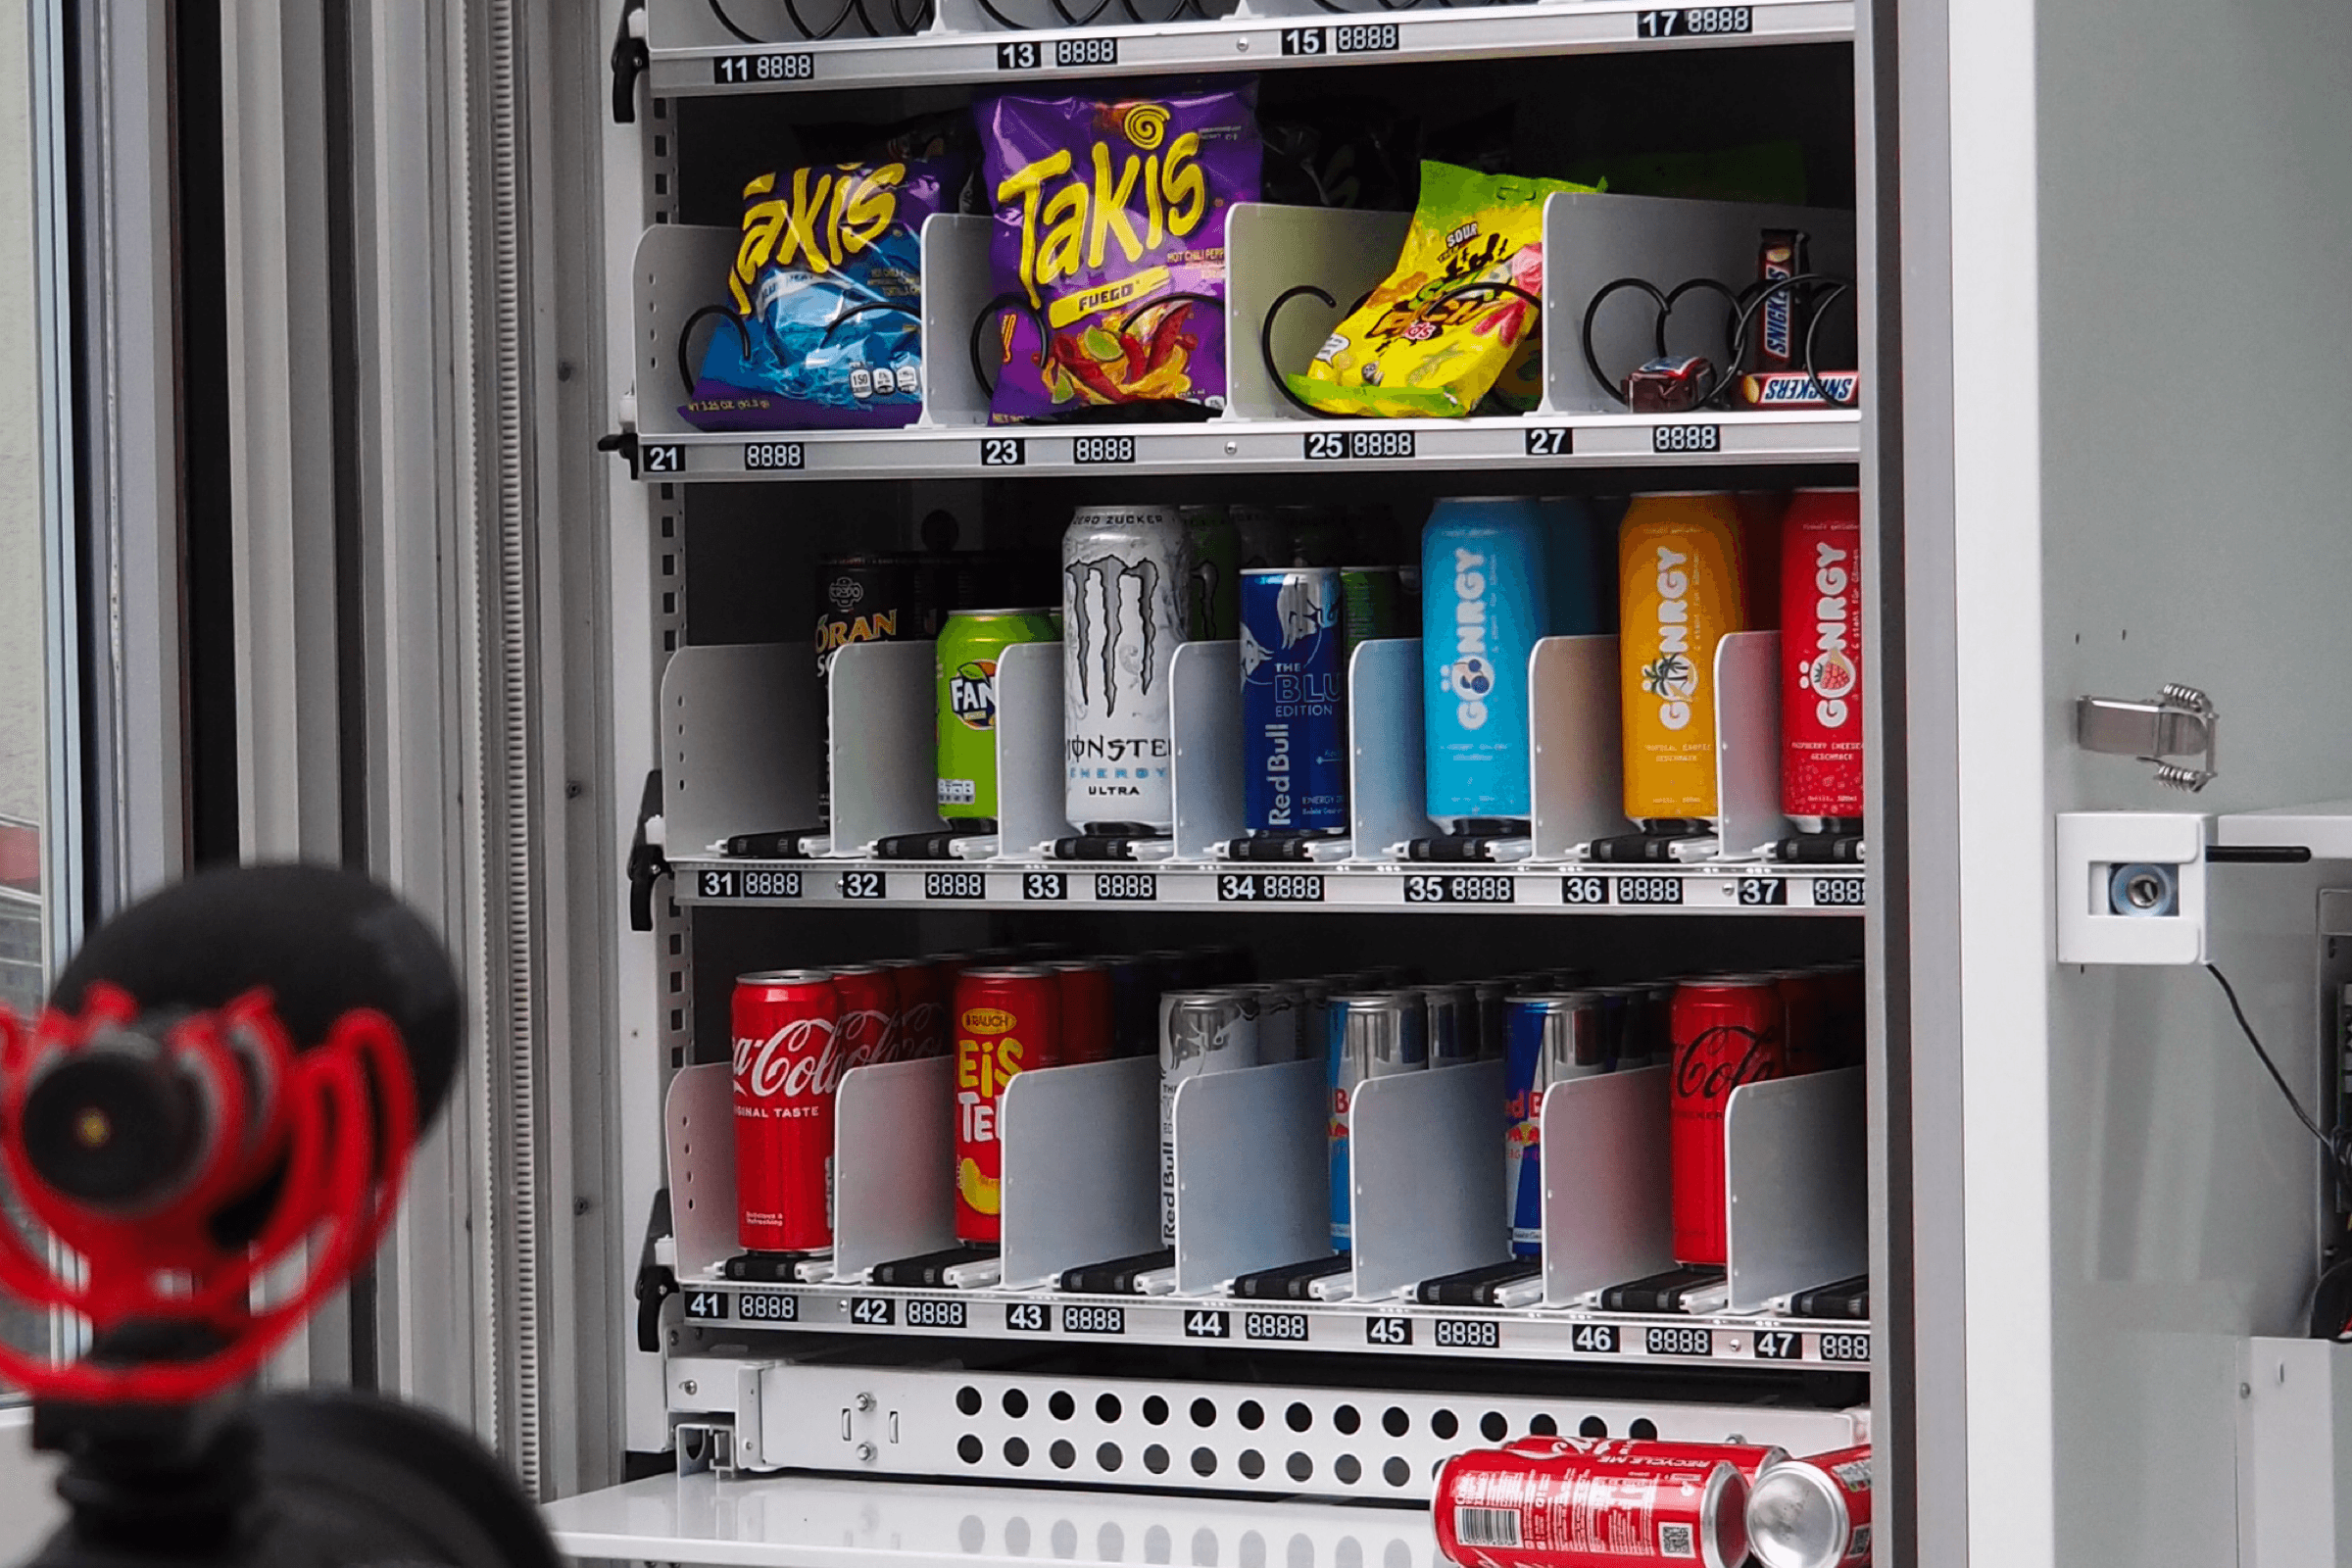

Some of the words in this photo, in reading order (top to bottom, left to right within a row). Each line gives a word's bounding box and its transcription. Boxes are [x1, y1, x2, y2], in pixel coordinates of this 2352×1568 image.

[1642, 11, 1677, 36] 17
[1287, 29, 1319, 54] 15
[1004, 44, 1034, 68] 13
[721, 58, 747, 81] 11
[1446, 222, 1478, 248] SOUR
[1079, 284, 1134, 311] FUEGO
[987, 440, 1017, 464] 23
[1309, 433, 1343, 457] 25
[1531, 429, 1565, 453] 27
[651, 448, 676, 469] 21
[1105, 514, 1163, 525] ZUCKER
[1275, 662, 1301, 672] THE
[1275, 705, 1333, 717] EDITION
[1264, 723, 1291, 772] Bull
[1089, 785, 1140, 796] ULTRA
[1266, 775, 1292, 826] Red
[706, 873, 731, 895] 31
[848, 874, 878, 896] 32
[1029, 875, 1059, 898] 33
[1223, 876, 1255, 899] 34
[1410, 877, 1443, 901] 35
[1568, 878, 1601, 902] 36
[1743, 880, 1778, 904] 37
[1815, 880, 1864, 903] 888
[773, 1105, 819, 1118] TASTE
[691, 1294, 717, 1316] 41
[855, 1299, 887, 1323] 42
[1010, 1305, 1042, 1329] 43
[1188, 1312, 1222, 1336] 44
[1371, 1319, 1404, 1343] 45
[1577, 1326, 1610, 1350] 46
[1758, 1333, 1792, 1356] 47
